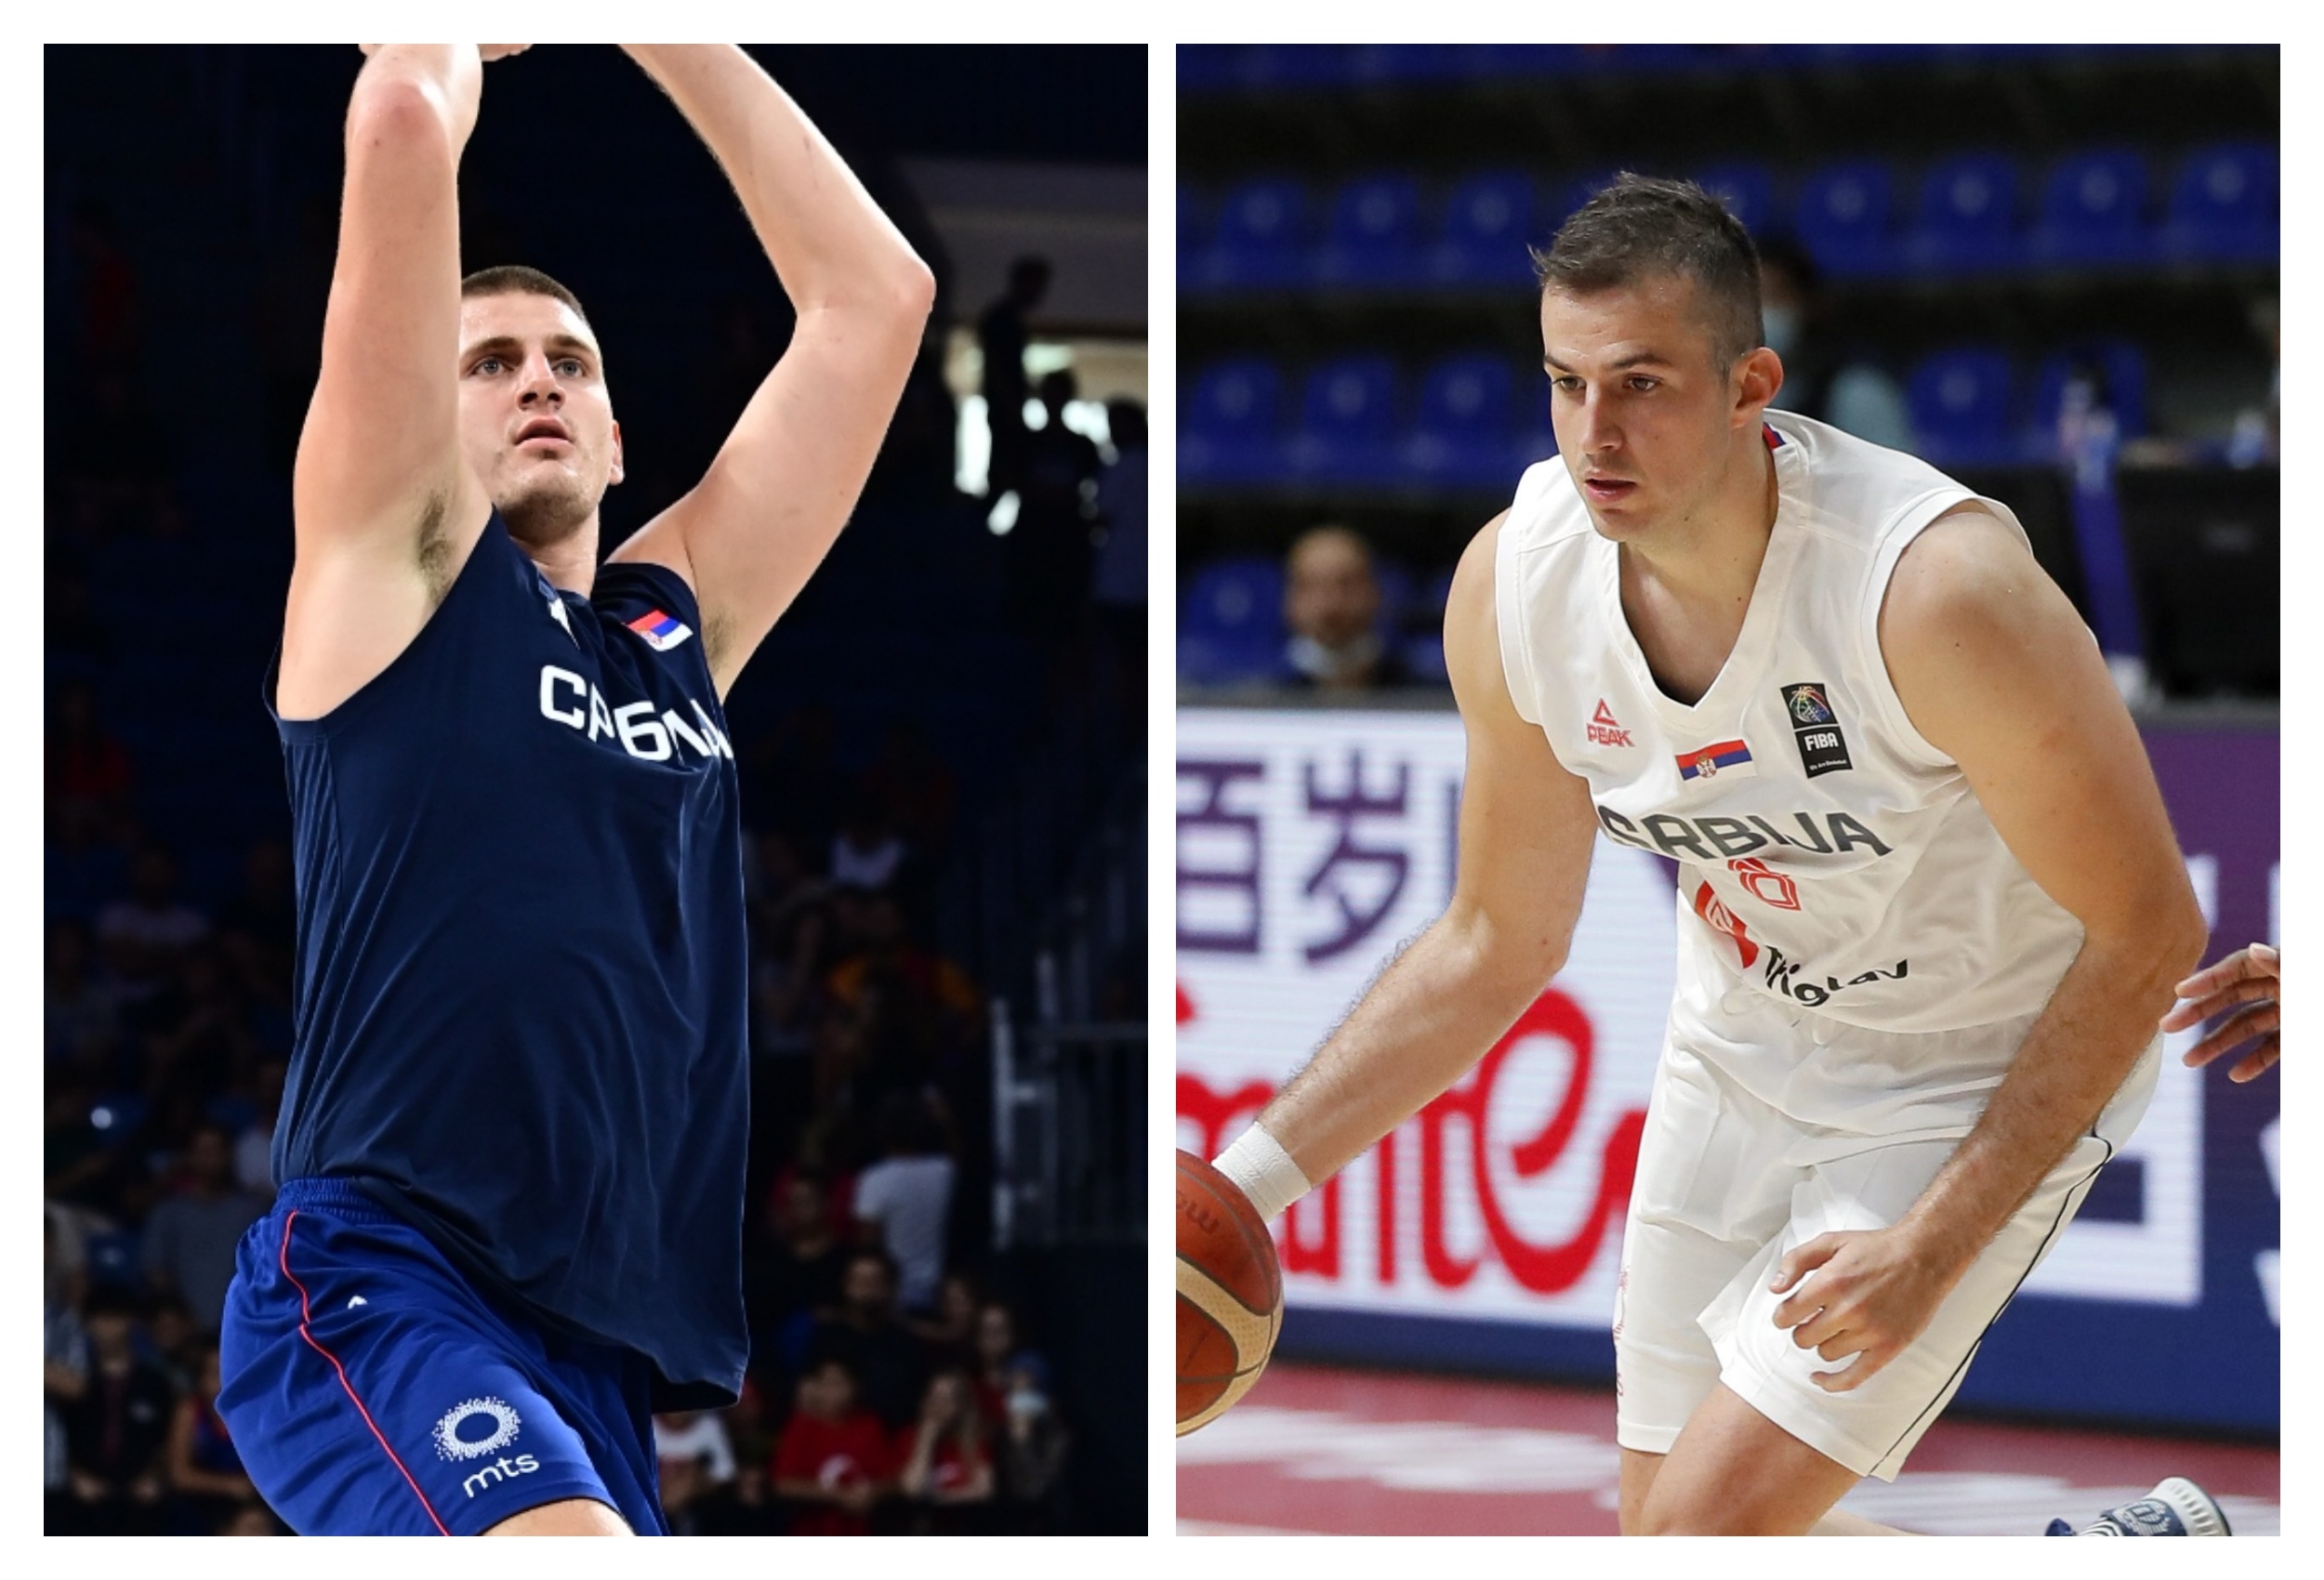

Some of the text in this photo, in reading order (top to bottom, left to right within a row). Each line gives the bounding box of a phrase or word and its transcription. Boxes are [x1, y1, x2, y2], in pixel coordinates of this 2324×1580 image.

[1586, 723, 1636, 747] PEAK
[1803, 731, 1839, 752] FIBA
[1597, 805, 1894, 859] SRBIJA
[462, 1454, 539, 1498] mts
